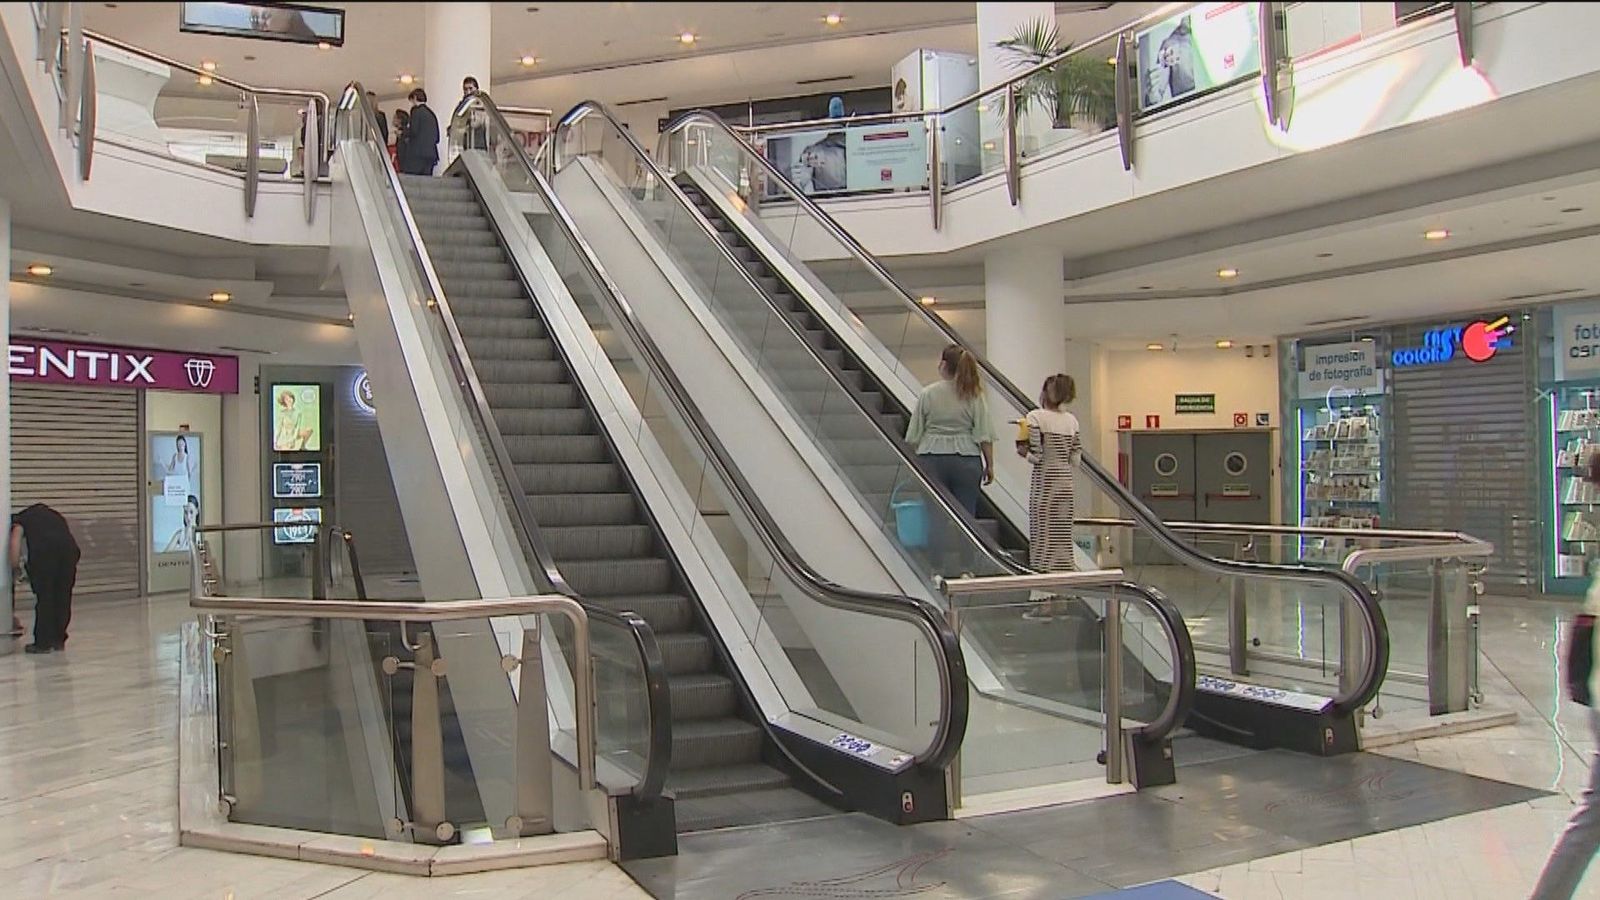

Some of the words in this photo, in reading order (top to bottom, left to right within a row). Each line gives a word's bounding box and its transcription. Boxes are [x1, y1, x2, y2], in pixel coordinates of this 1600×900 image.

[1575, 323, 1600, 341] fot
[1309, 369, 1322, 381] de
[1324, 365, 1373, 381] fotografía
